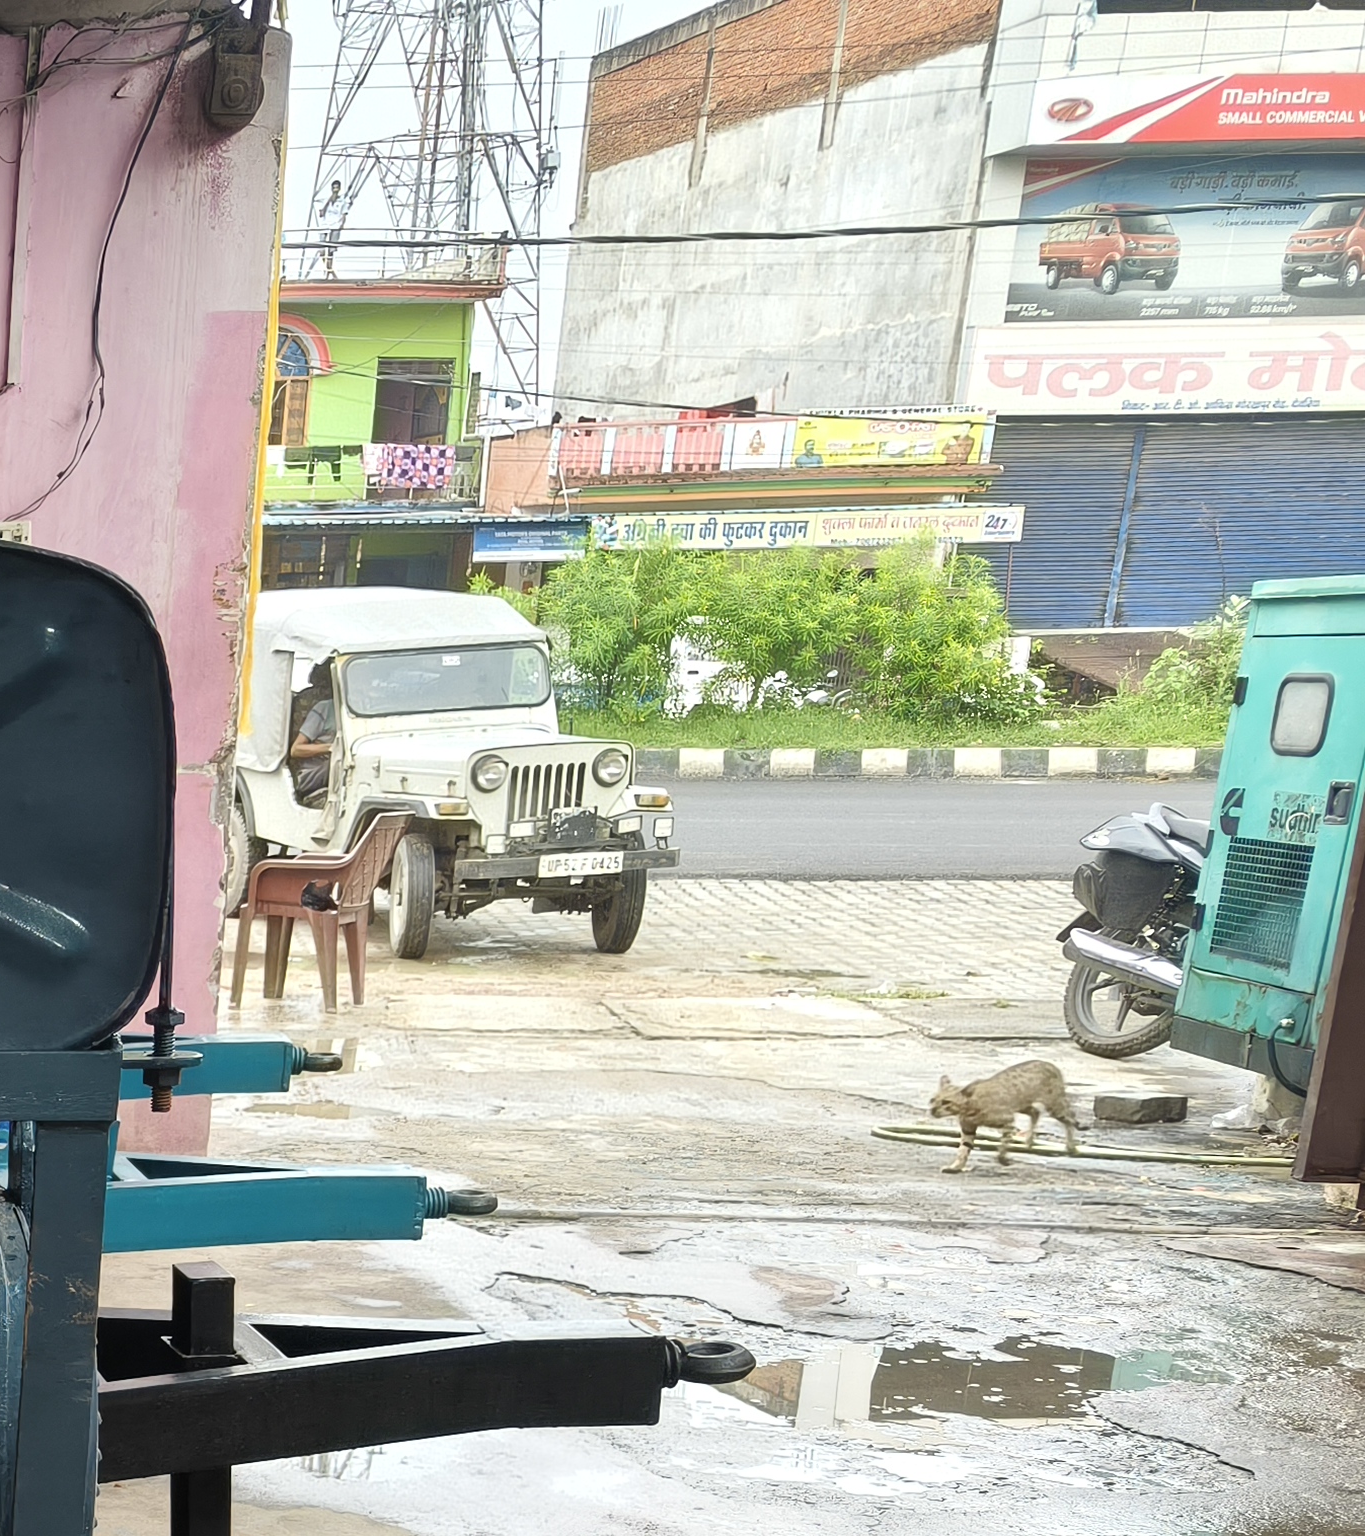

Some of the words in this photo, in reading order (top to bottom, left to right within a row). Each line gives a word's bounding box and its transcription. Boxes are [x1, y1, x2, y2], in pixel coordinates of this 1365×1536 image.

[1220, 87, 1330, 105] Mahindra
[1218, 111, 1263, 125] SMALL
[1266, 110, 1355, 124] COMMERCIAL
[984, 350, 1226, 398] पलक
[1247, 330, 1365, 393] मो
[698, 517, 719, 541] की
[721, 521, 766, 547] फुटकर
[768, 520, 809, 547] दुकान
